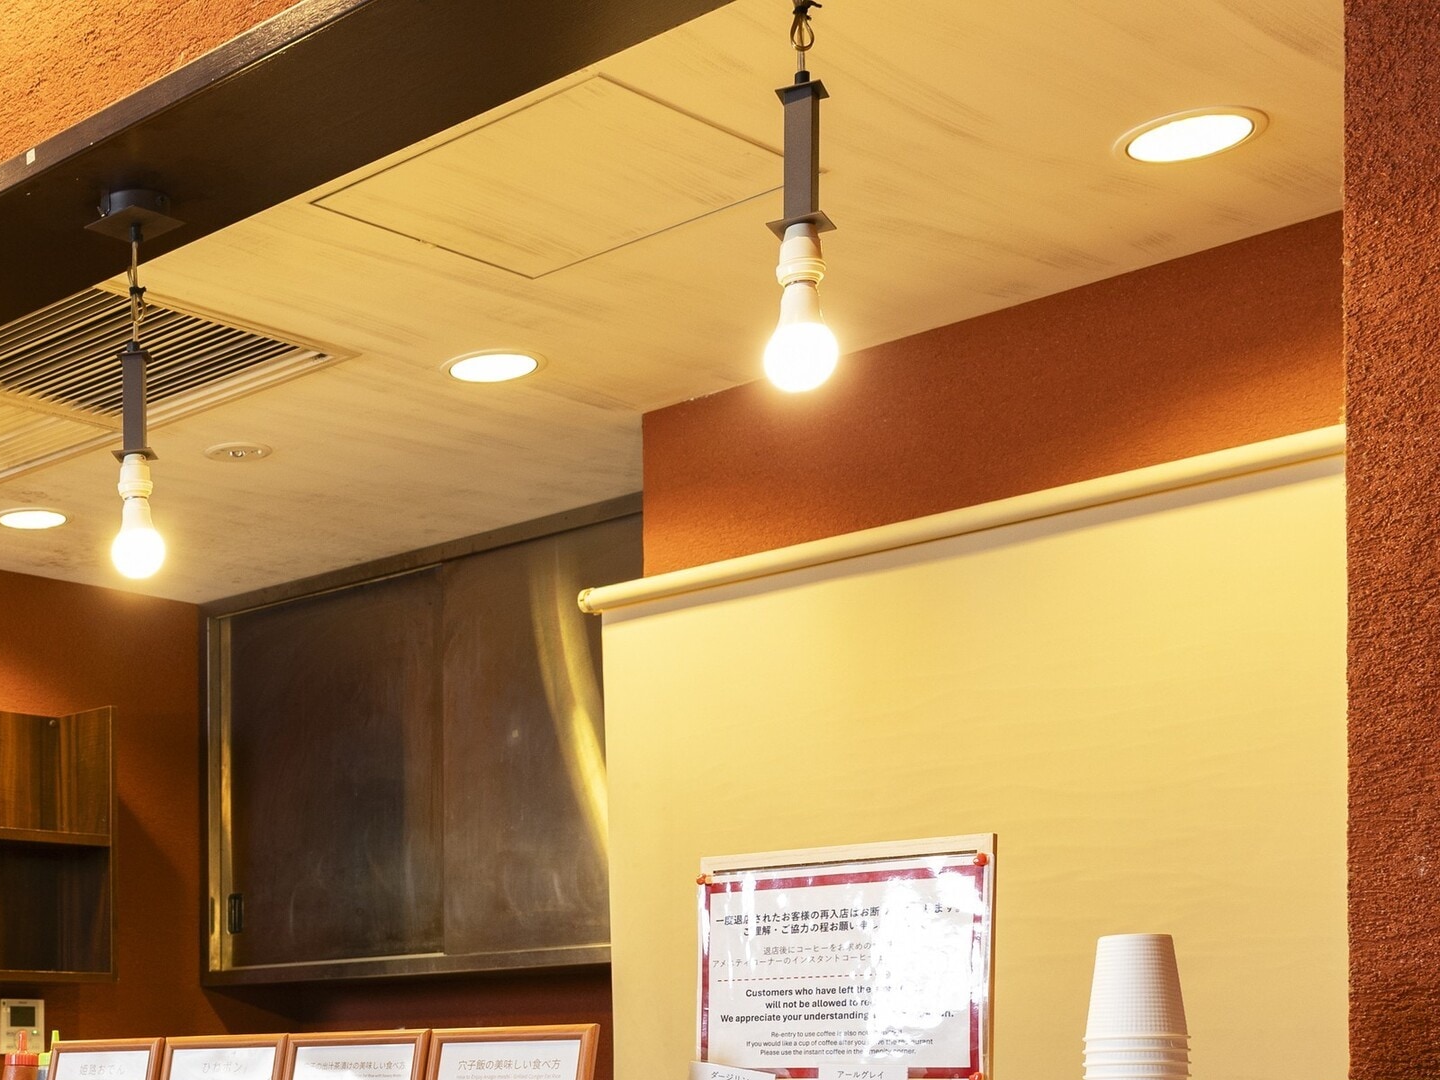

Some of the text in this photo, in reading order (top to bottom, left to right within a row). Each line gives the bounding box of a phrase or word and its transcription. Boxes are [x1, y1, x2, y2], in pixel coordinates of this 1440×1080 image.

[745, 988, 793, 997] Customers
[795, 987, 813, 996] who
[815, 986, 836, 995] have
[839, 986, 854, 994] left
[765, 1000, 780, 1009] will
[782, 1000, 797, 1008] not
[799, 999, 810, 1008] be
[812, 998, 847, 1007] allowed
[849, 999, 858, 1007] to
[720, 1014, 734, 1023] We
[735, 1013, 780, 1024] appreciate
[782, 1013, 802, 1023] your
[804, 1011, 869, 1021] understanding
[771, 1031, 796, 1039] Re-entry
[458, 1058, 561, 1071] 穴子飯の美味しい食べ方
[837, 1070, 884, 1079] アールグレイ
